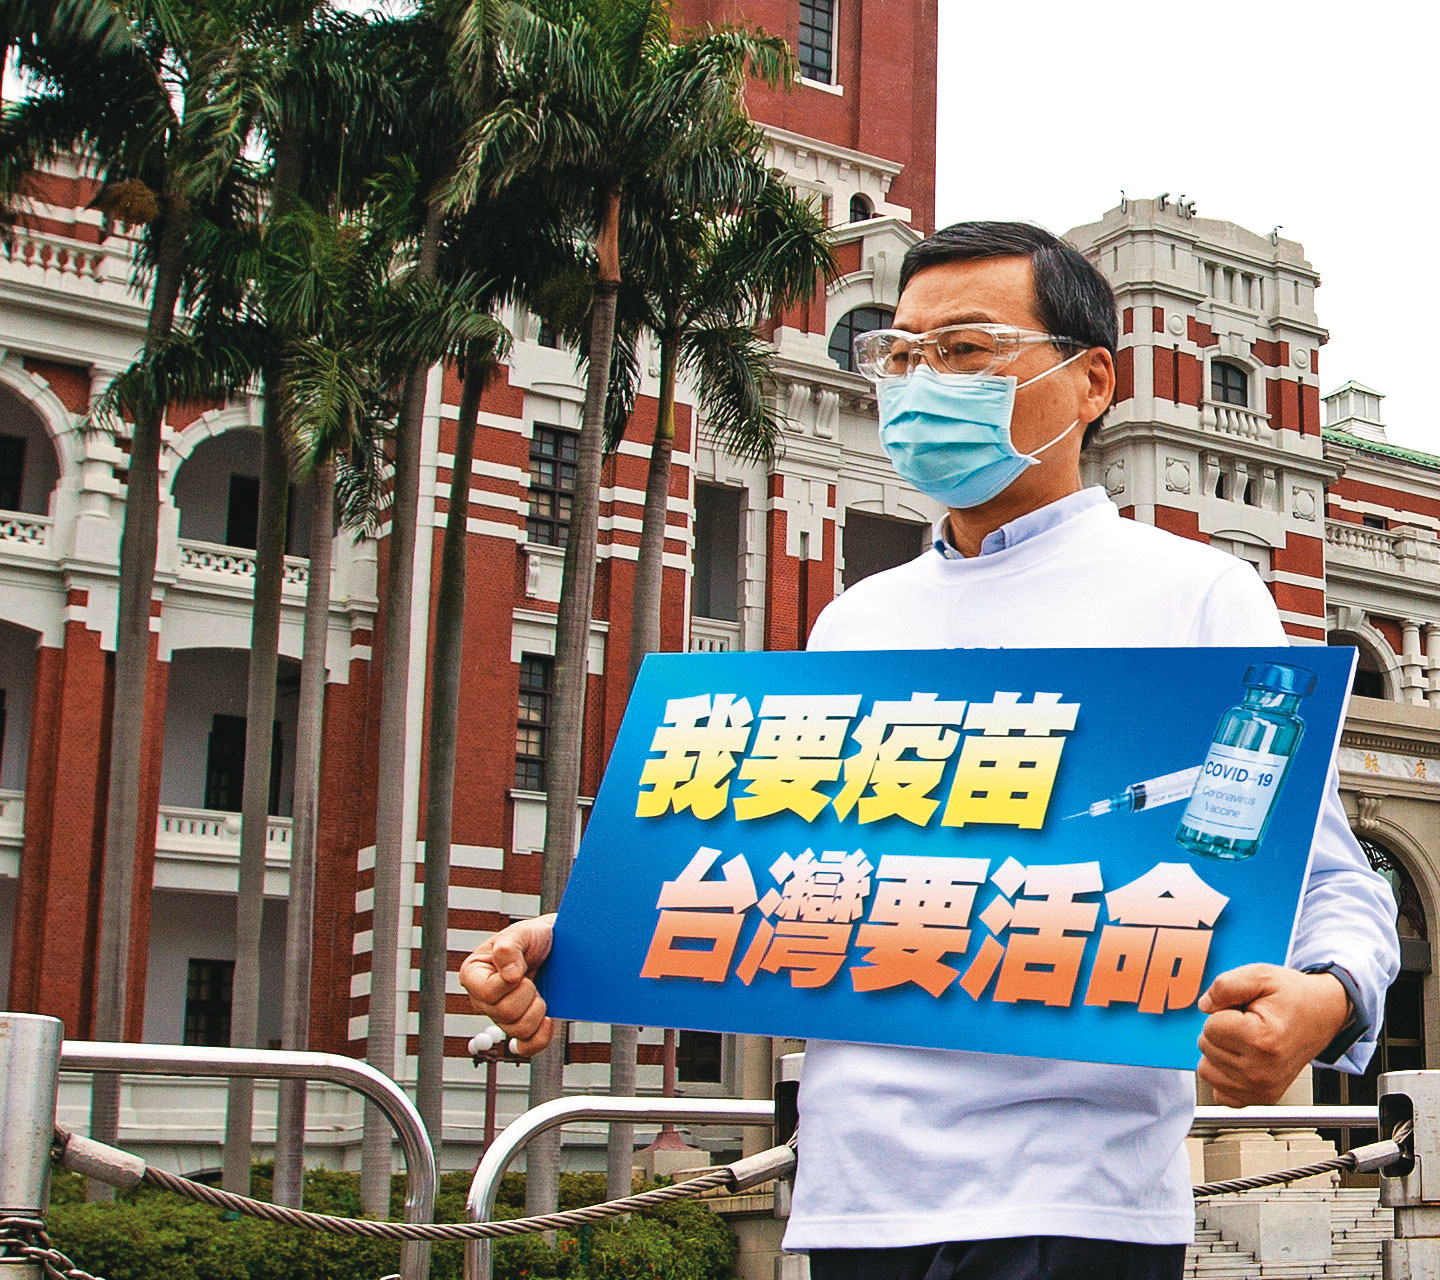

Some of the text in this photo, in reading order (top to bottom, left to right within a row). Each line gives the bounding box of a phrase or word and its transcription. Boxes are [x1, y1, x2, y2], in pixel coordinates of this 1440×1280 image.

[635, 691, 1081, 830] 我要疫苗
[1205, 760, 1274, 788] COVID-19
[1202, 785, 1257, 806] Coronavirus
[1205, 801, 1241, 819] Vaccine
[640, 848, 1231, 1015] 台灣要活命
